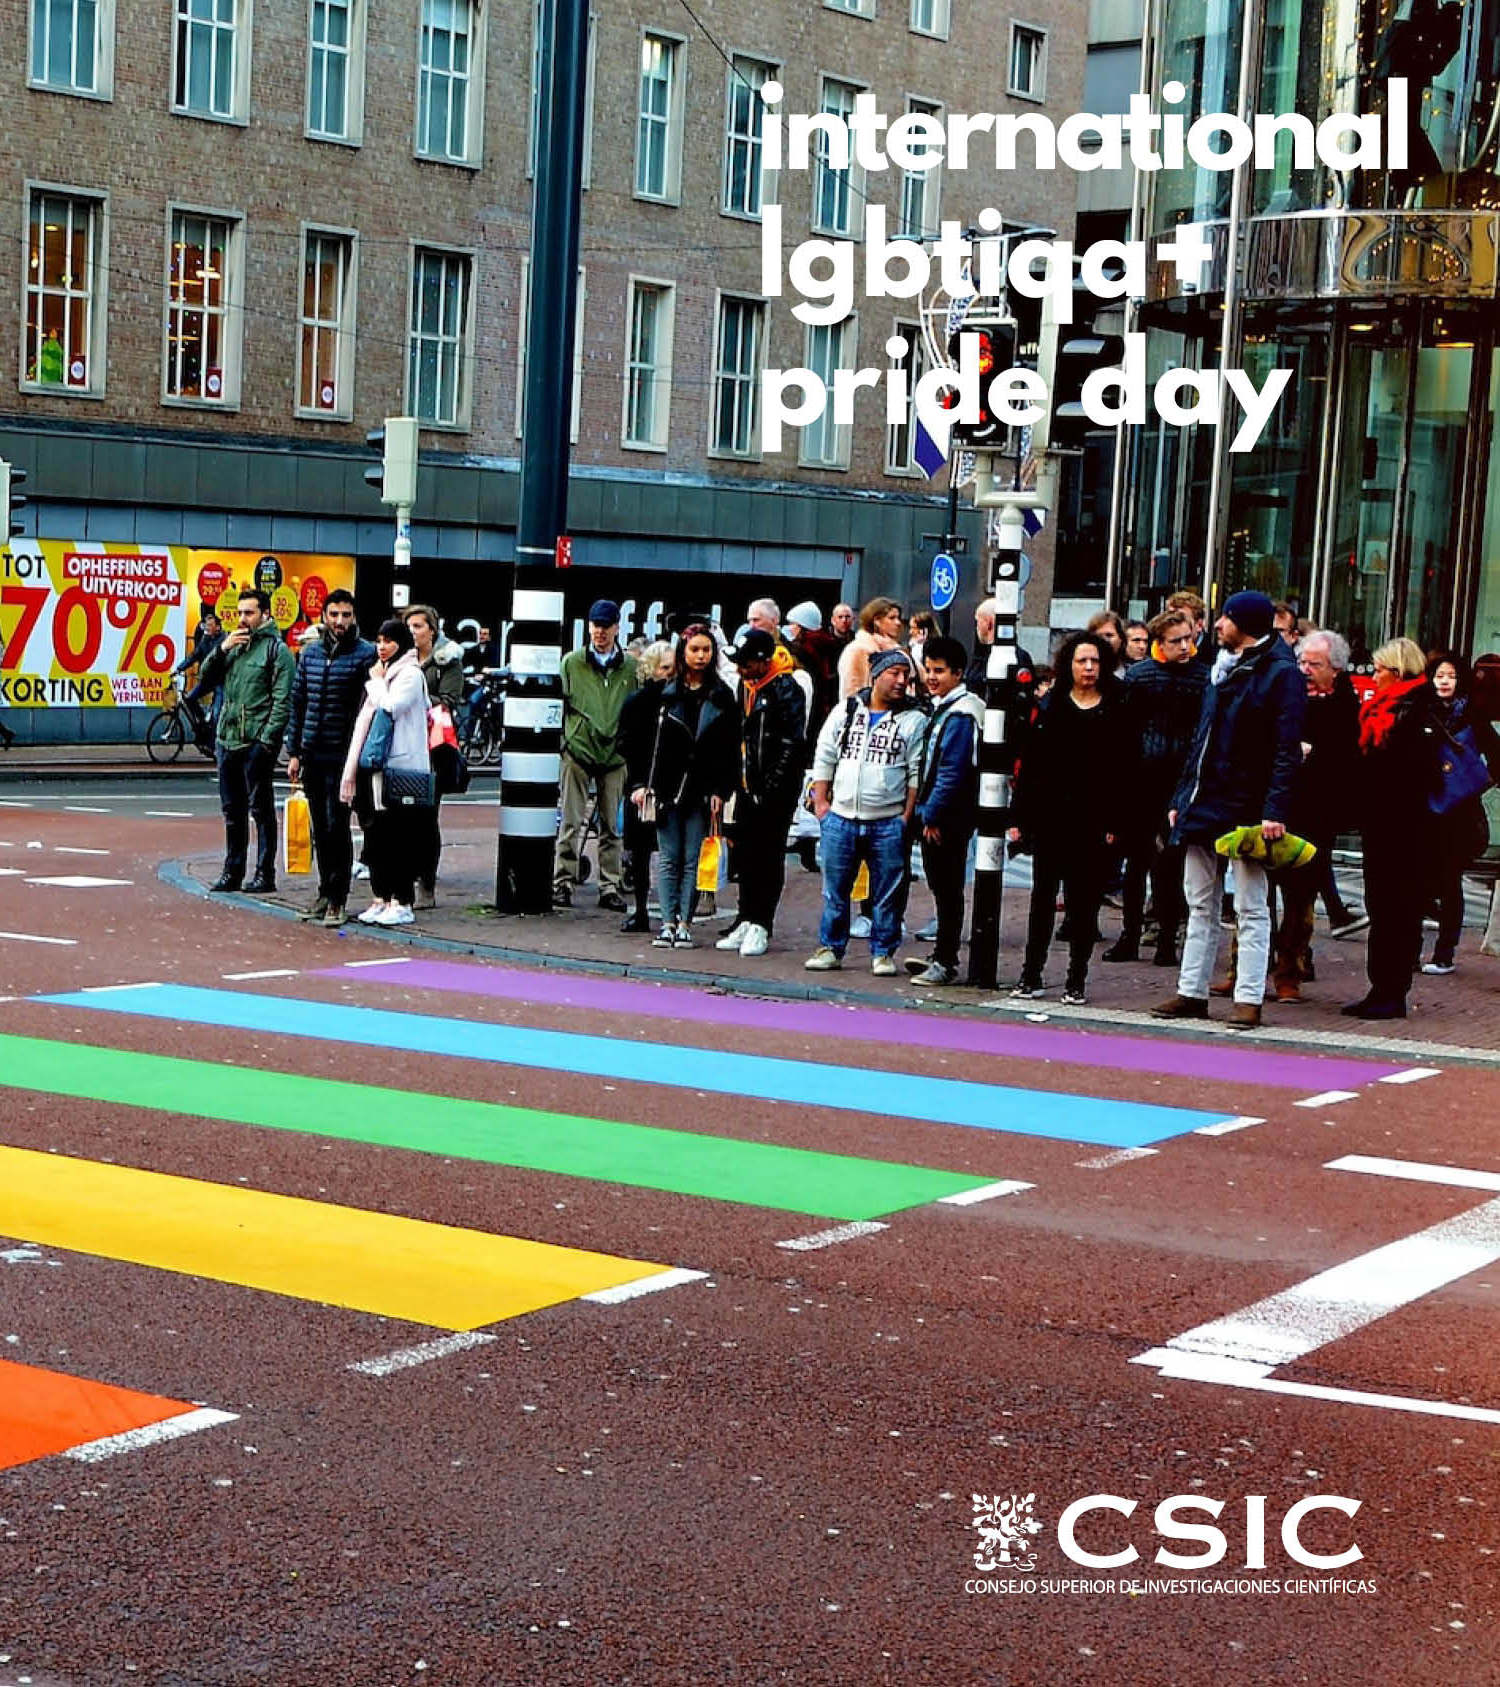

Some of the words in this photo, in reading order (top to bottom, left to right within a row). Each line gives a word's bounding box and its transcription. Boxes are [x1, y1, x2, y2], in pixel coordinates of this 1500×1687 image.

[3, 554, 45, 579] TOT
[67, 557, 164, 578] OPHEFFINGS
[81, 575, 179, 602] UITVERKOOP
[0, 585, 175, 674] 70%
[112, 678, 128, 691] WE
[130, 677, 163, 690] GAAN
